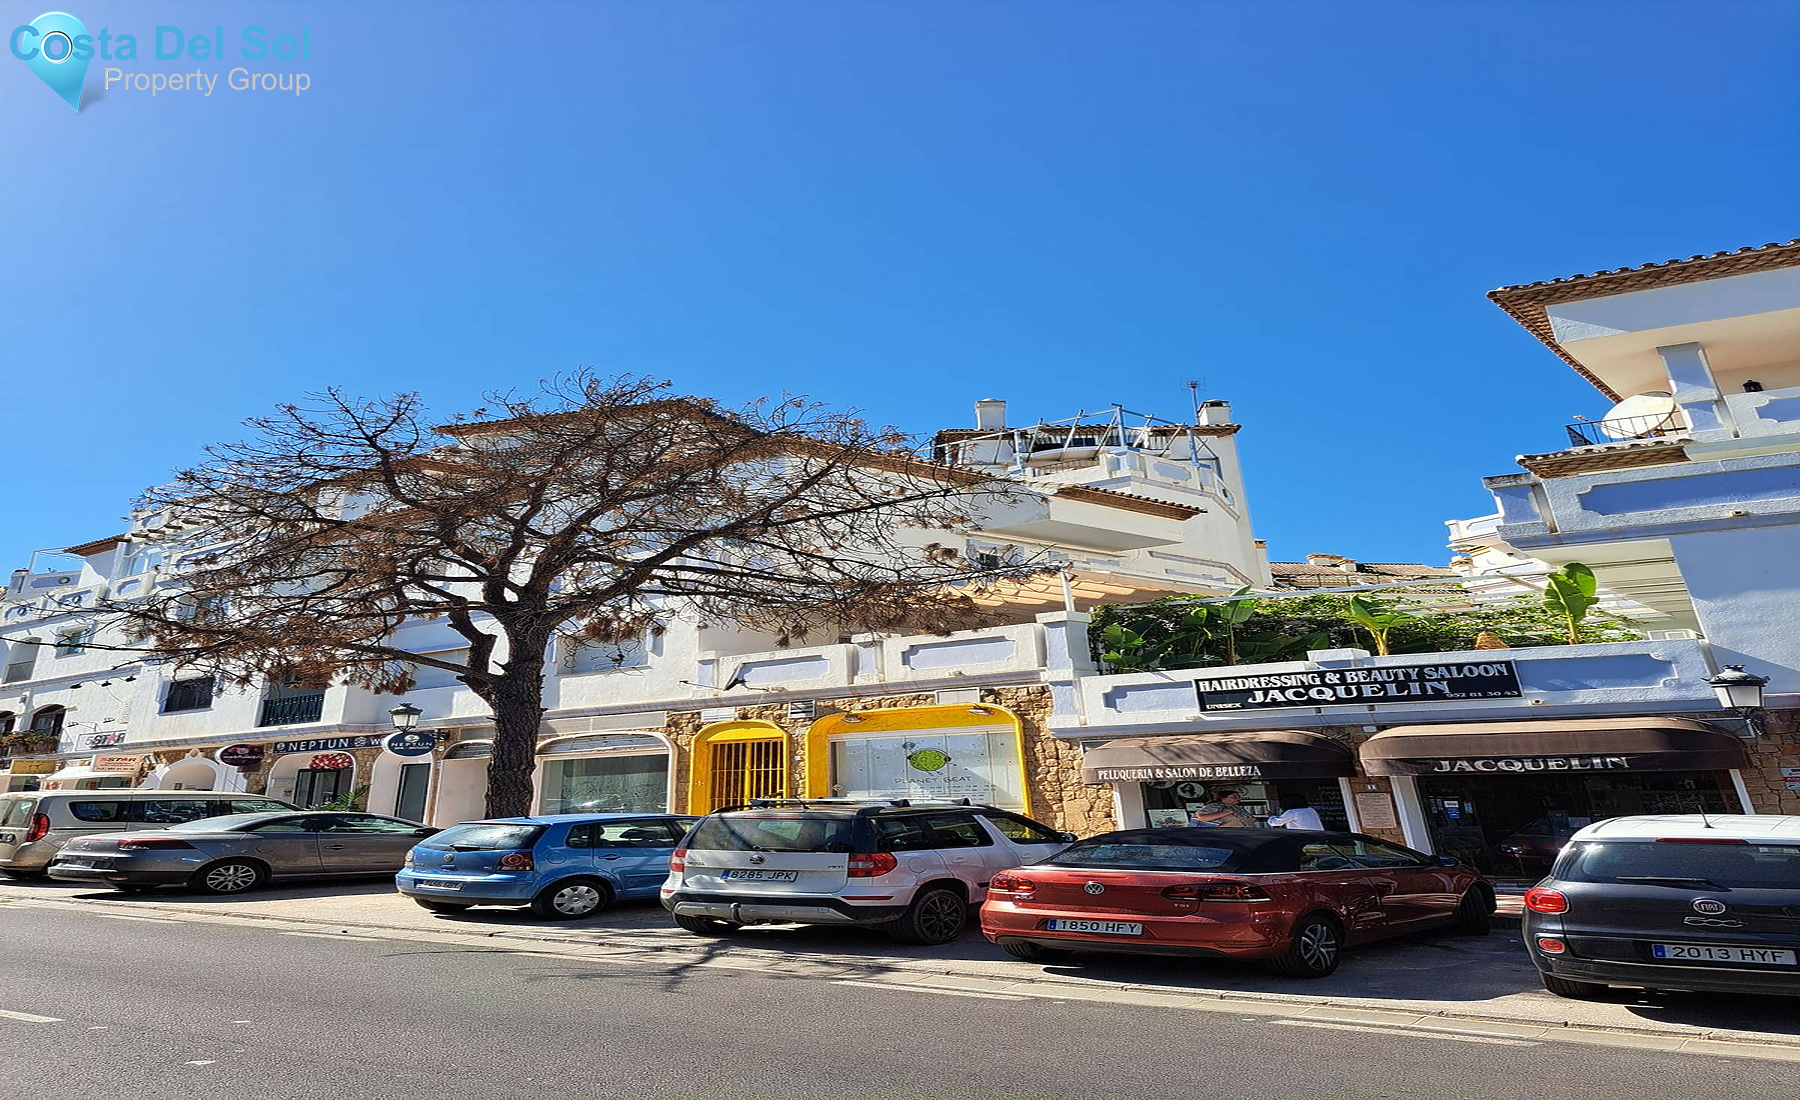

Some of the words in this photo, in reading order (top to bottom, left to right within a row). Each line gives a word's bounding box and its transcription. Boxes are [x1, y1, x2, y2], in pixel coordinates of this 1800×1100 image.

[1198, 673, 1320, 692] HAIRDRESSING
[1325, 672, 1341, 684] &
[1345, 667, 1420, 683] BEAUTY
[1424, 663, 1509, 680] SALOON
[1247, 680, 1451, 703] JACQUELIN
[1206, 702, 1242, 710] UNISEX
[287, 738, 349, 751] NEPTUN
[1433, 756, 1630, 773] JACQUELIN
[1098, 768, 1152, 780] PELUQUERIA
[1155, 768, 1164, 778] &
[1165, 767, 1197, 778] SALON
[1199, 767, 1213, 777] DE
[1215, 766, 1262, 777] BELLEZA
[731, 871, 763, 880] 8285
[767, 871, 794, 880] JPK
[1061, 920, 1100, 931] 1850
[1105, 922, 1138, 934] HFY
[1672, 947, 1731, 960] 2013
[1740, 949, 1785, 962] HYF
